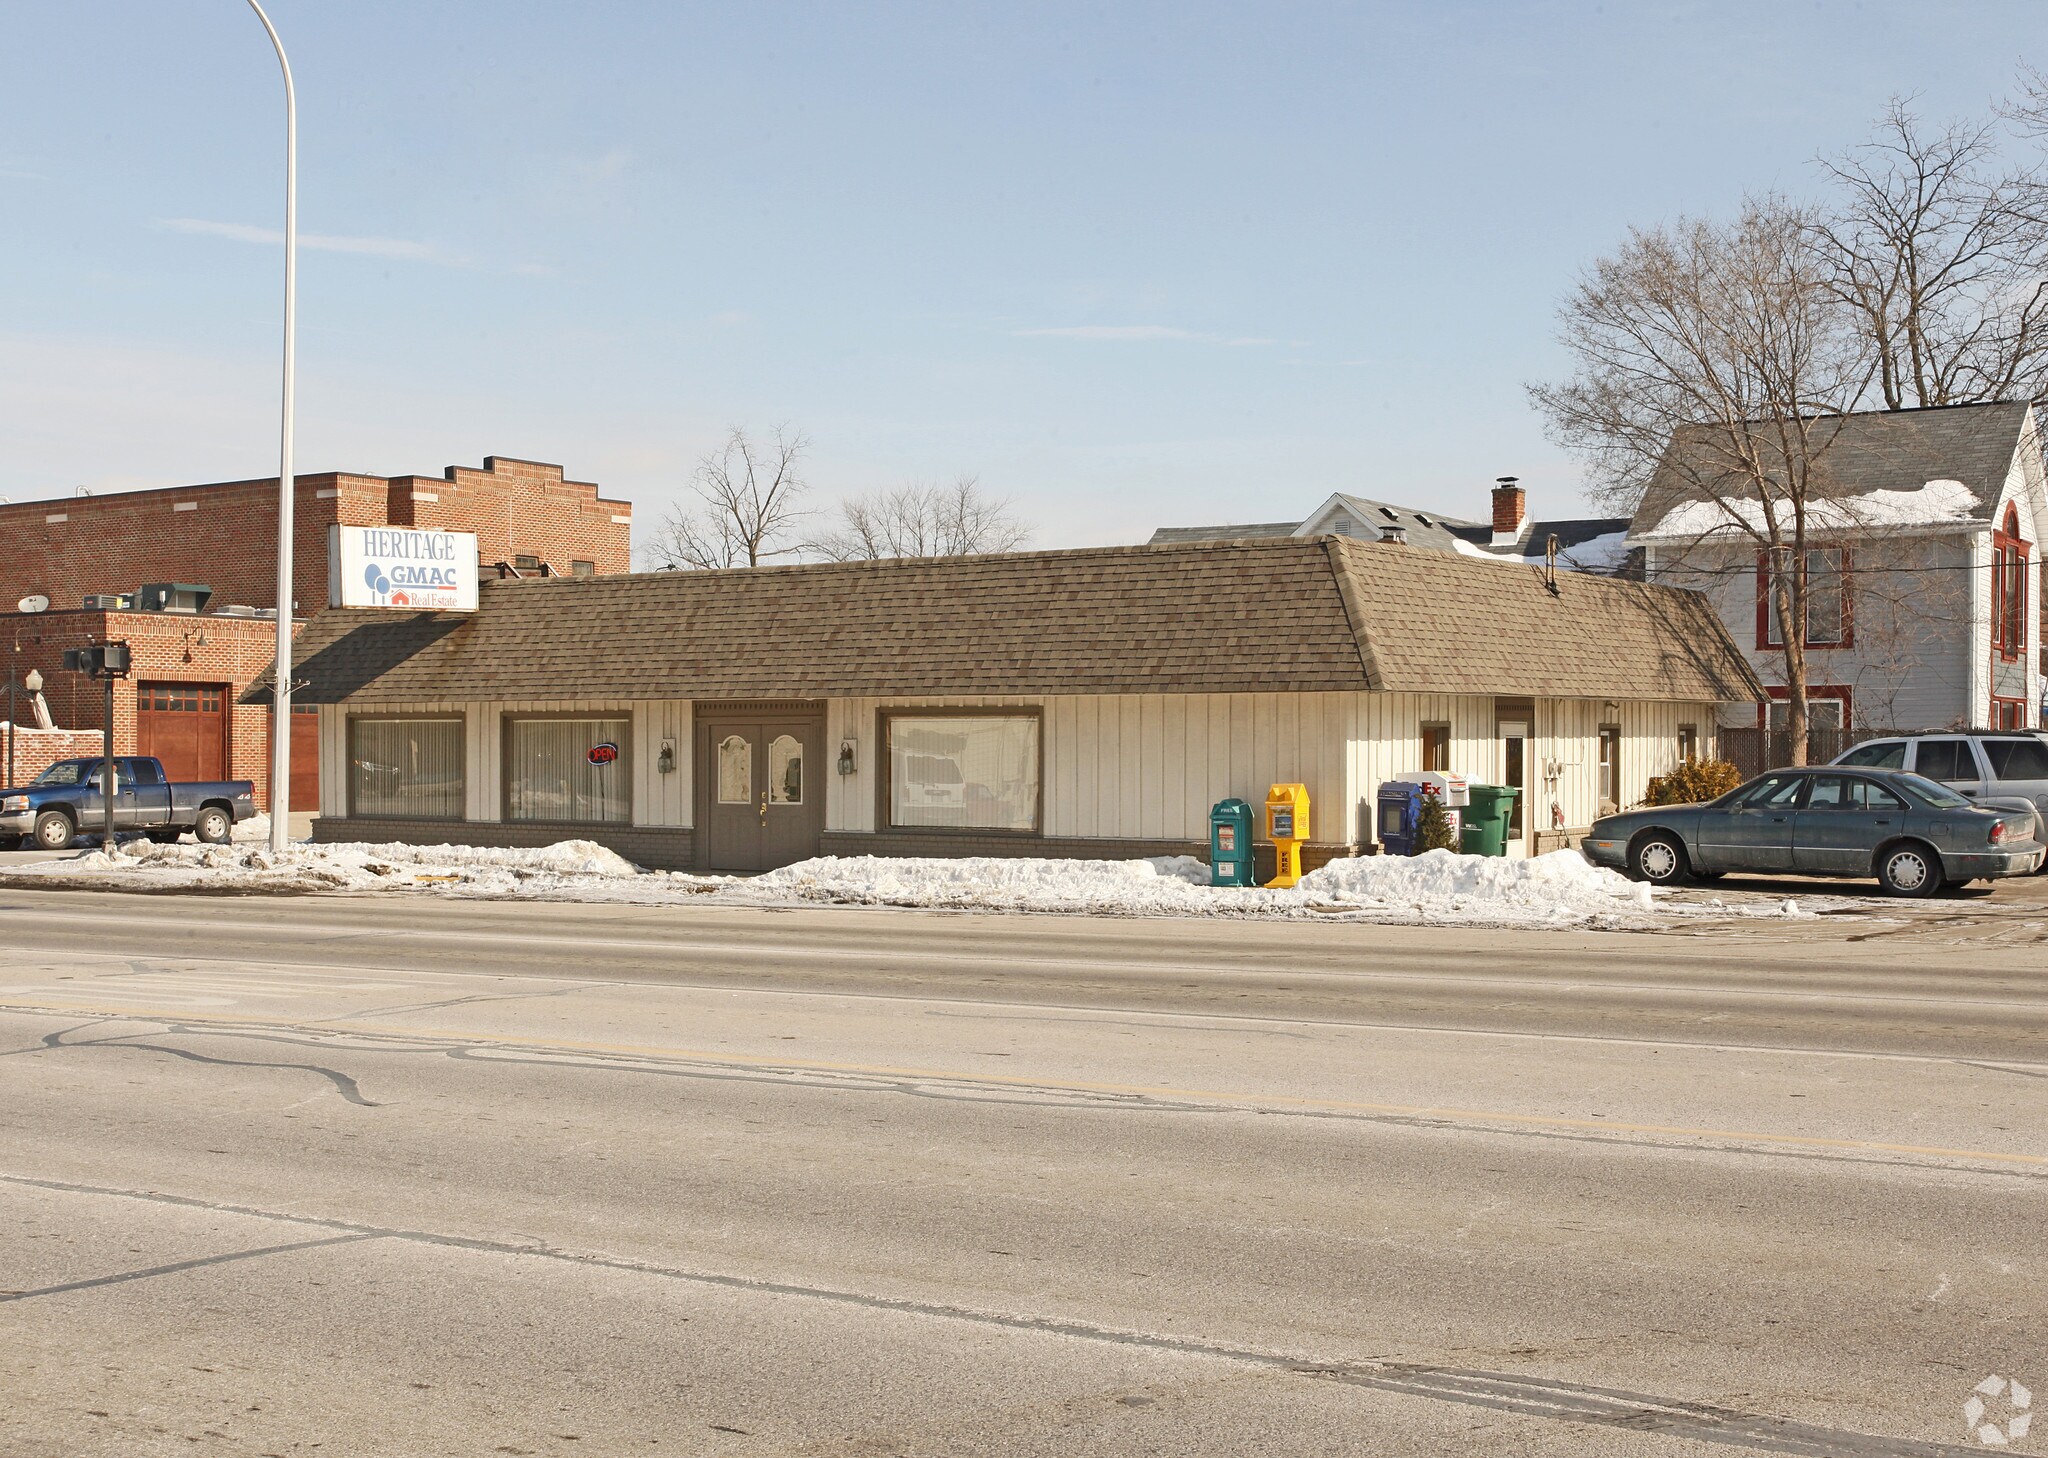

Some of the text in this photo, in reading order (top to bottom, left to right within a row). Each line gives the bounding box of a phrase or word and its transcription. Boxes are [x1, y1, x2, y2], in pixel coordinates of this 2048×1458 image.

[363, 529, 456, 561] HERITAGE
[390, 565, 457, 585] GMAC
[411, 593, 458, 607] Real Estate
[587, 747, 616, 761] OPEN
[1419, 781, 1442, 795] Ex
[1281, 851, 1289, 873] FREE
